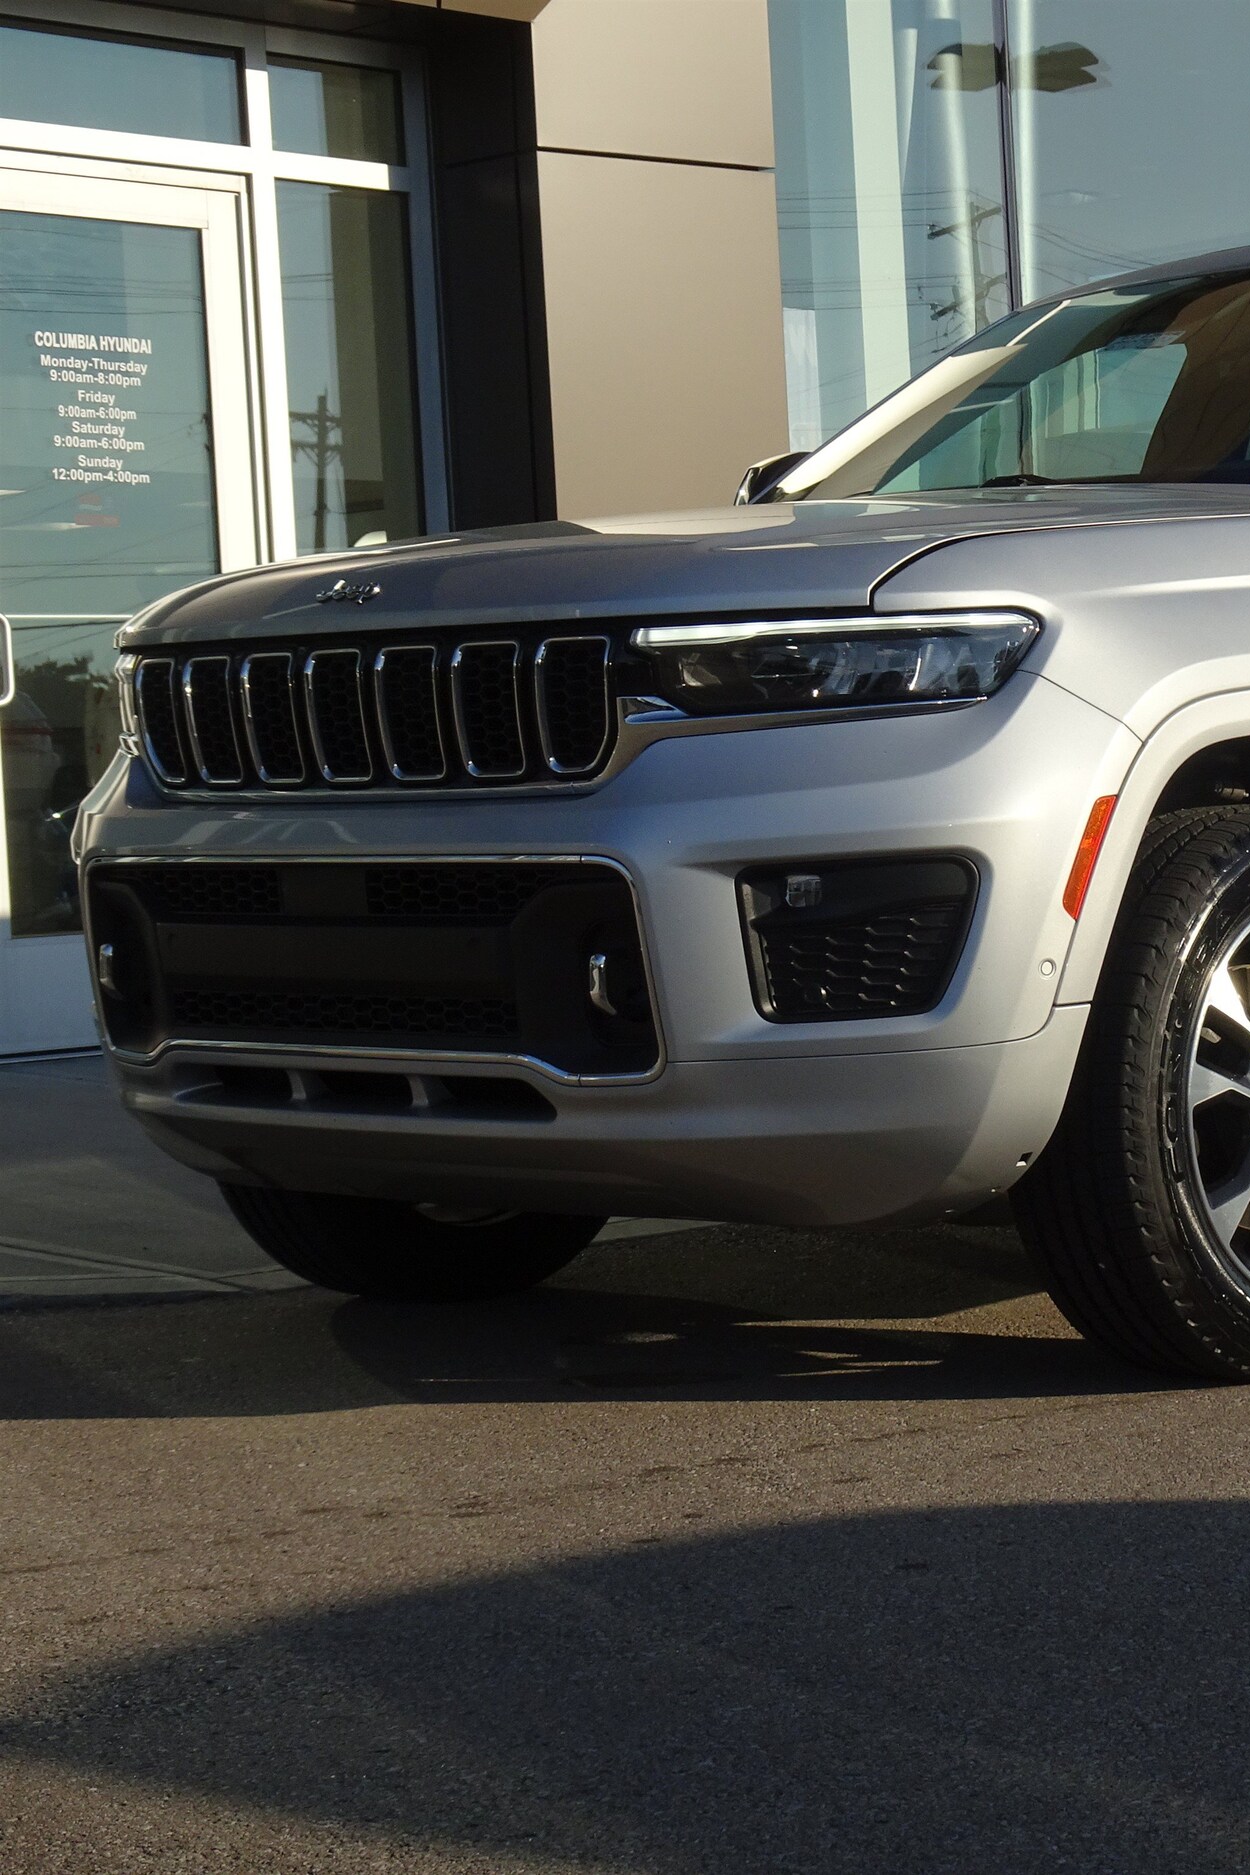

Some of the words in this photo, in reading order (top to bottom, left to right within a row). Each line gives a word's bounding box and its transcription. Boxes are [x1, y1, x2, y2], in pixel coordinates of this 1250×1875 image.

[35, 331, 98, 350] COLUMBIA
[100, 336, 152, 354] HYUNDAI
[40, 354, 148, 376] Monday-Thursday
[50, 369, 141, 388] 9:00am-8:00pm
[77, 390, 116, 406] Friday
[58, 405, 137, 422] 9:00am-6:00pm
[71, 421, 125, 437] Saturday
[54, 435, 145, 452] 9:00am-6:00pm
[77, 454, 124, 470] Sunday
[52, 468, 150, 484] 12:00pm-4:00pm
[316, 579, 381, 604] Jeep
